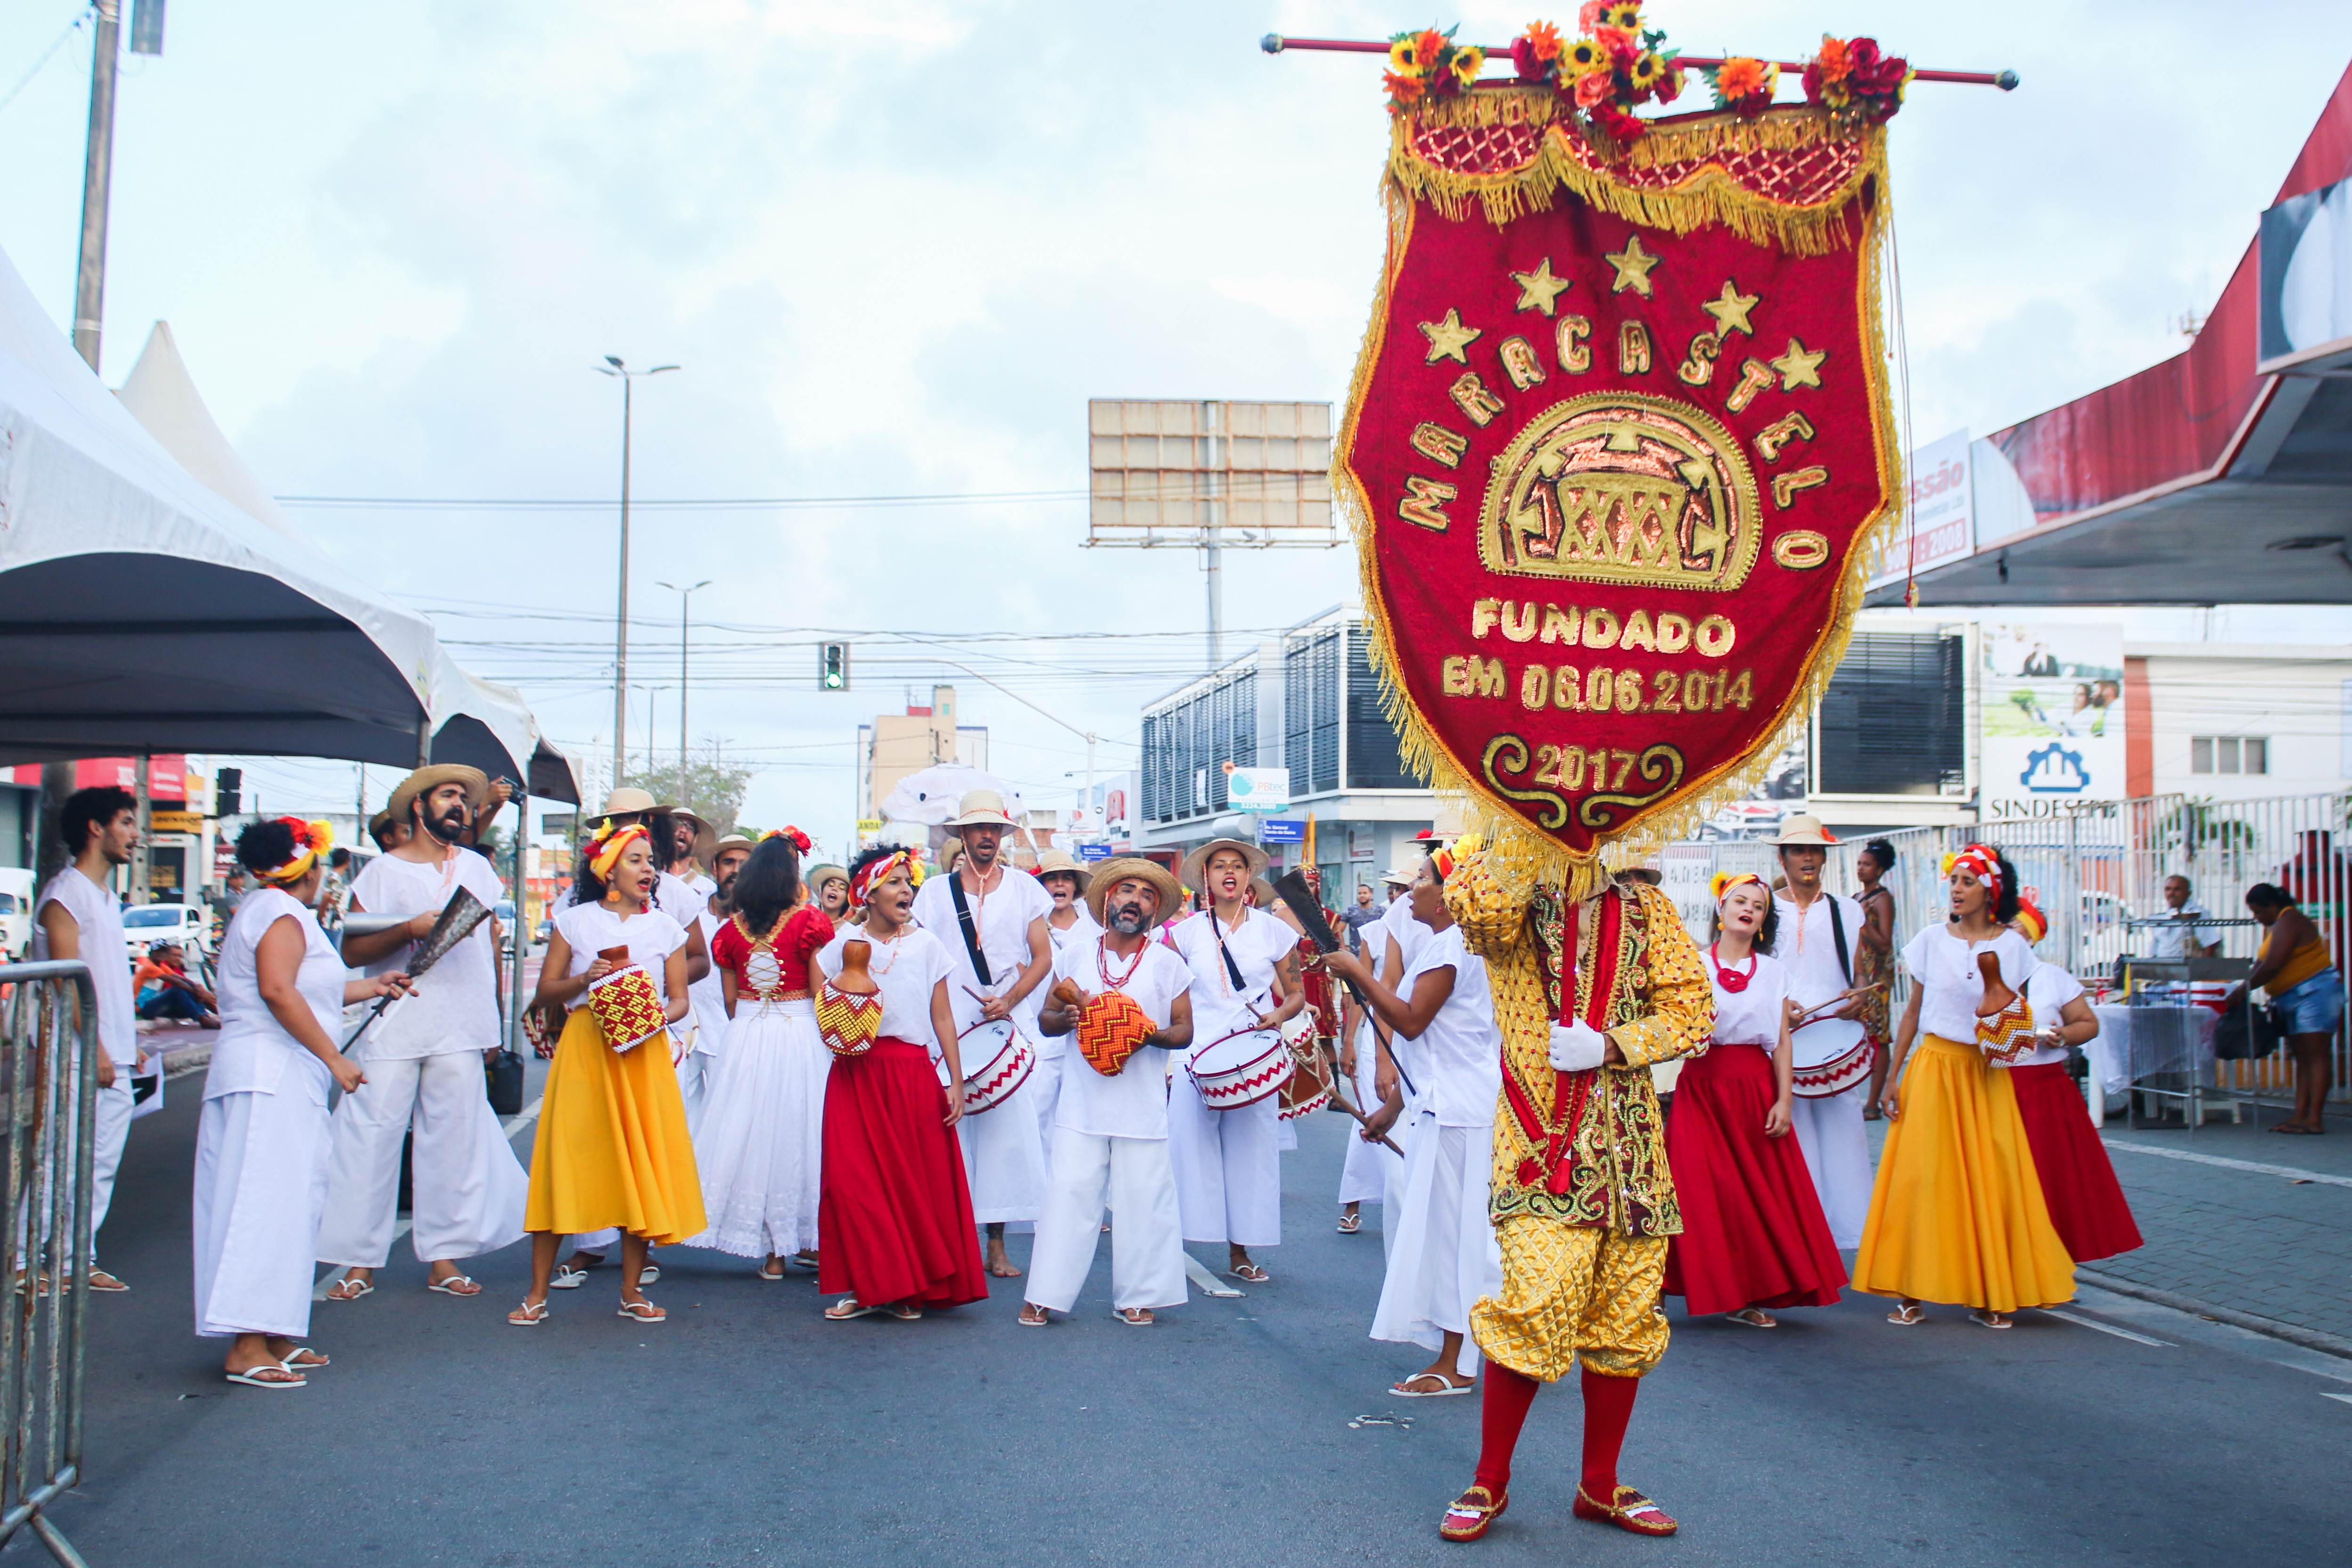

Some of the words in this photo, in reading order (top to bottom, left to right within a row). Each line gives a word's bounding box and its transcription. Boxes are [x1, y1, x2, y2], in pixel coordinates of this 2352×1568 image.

[1398, 314, 1829, 570] MARACASTELO
[1929, 522, 1964, 557] 2008
[1472, 597, 1737, 657] FUNDADO
[1442, 654, 1507, 699] EM
[1521, 663, 1755, 714] 06.06.2014
[1257, 782, 1286, 792] PBtec
[1532, 743, 1639, 792] 2017
